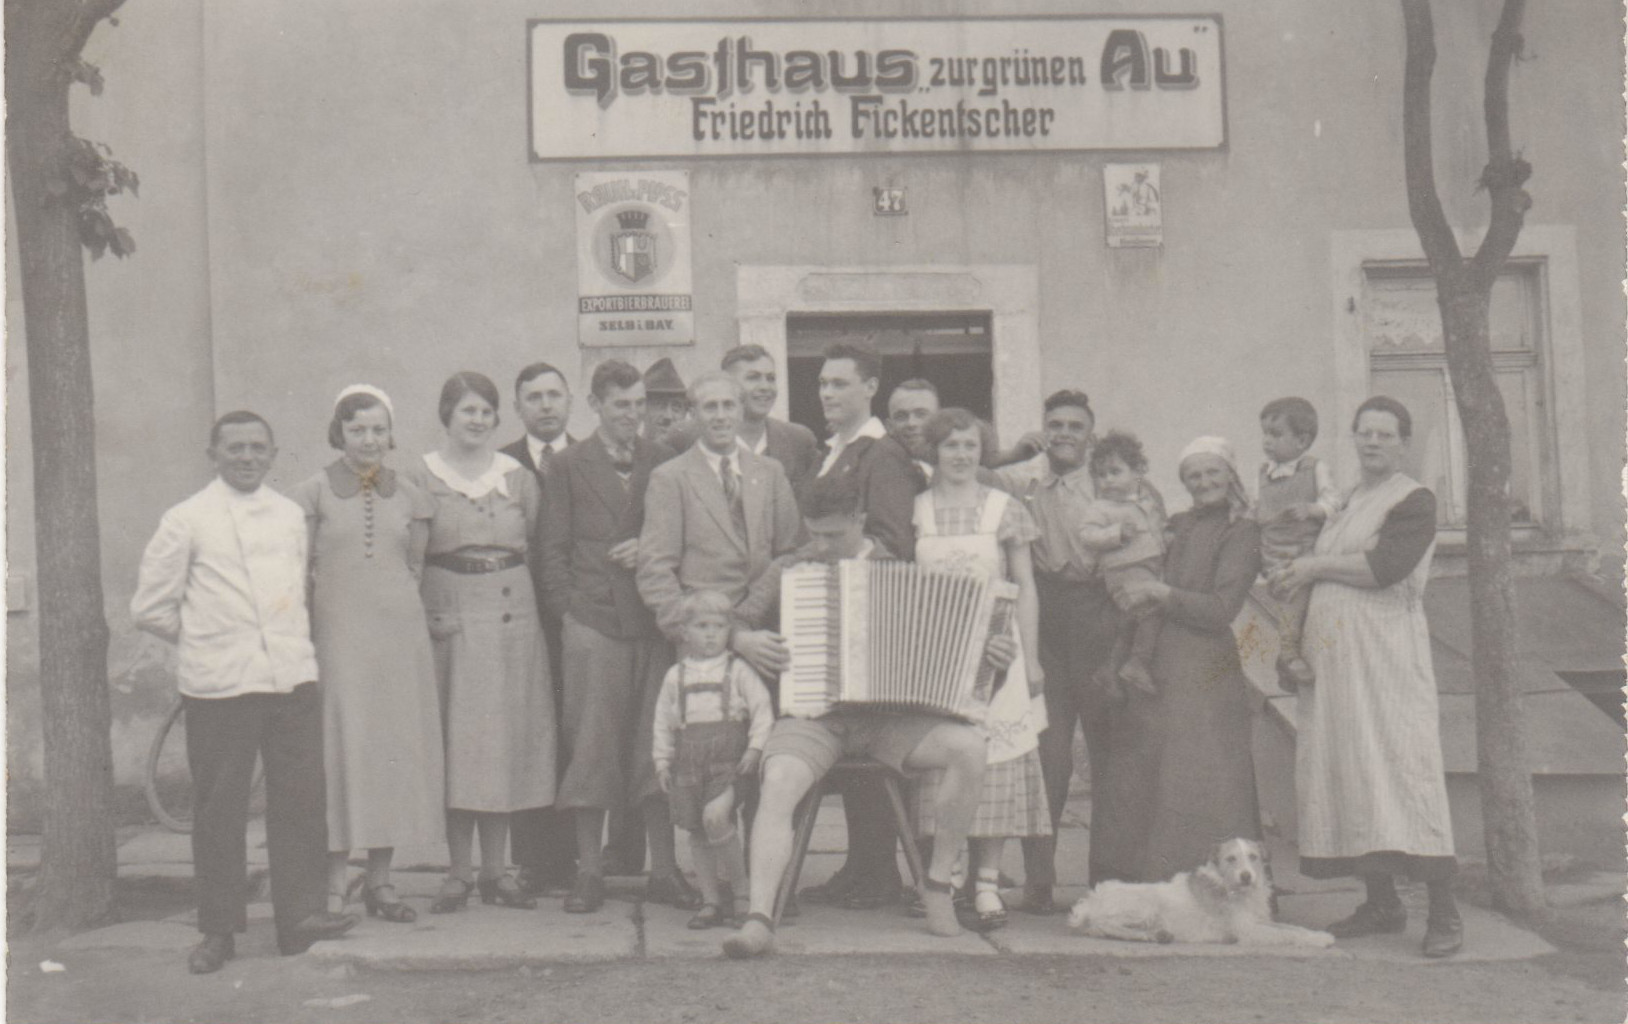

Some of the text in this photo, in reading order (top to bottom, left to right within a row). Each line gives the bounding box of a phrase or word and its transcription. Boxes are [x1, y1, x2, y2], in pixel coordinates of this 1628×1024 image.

[563, 33, 919, 110] Gasthaus
[690, 95, 1055, 141] Friedrich Fickentscher
[878, 190, 903, 211] 47
[581, 296, 690, 312] EXPORTBIERBRAUEREI
[599, 320, 635, 331] SELB
